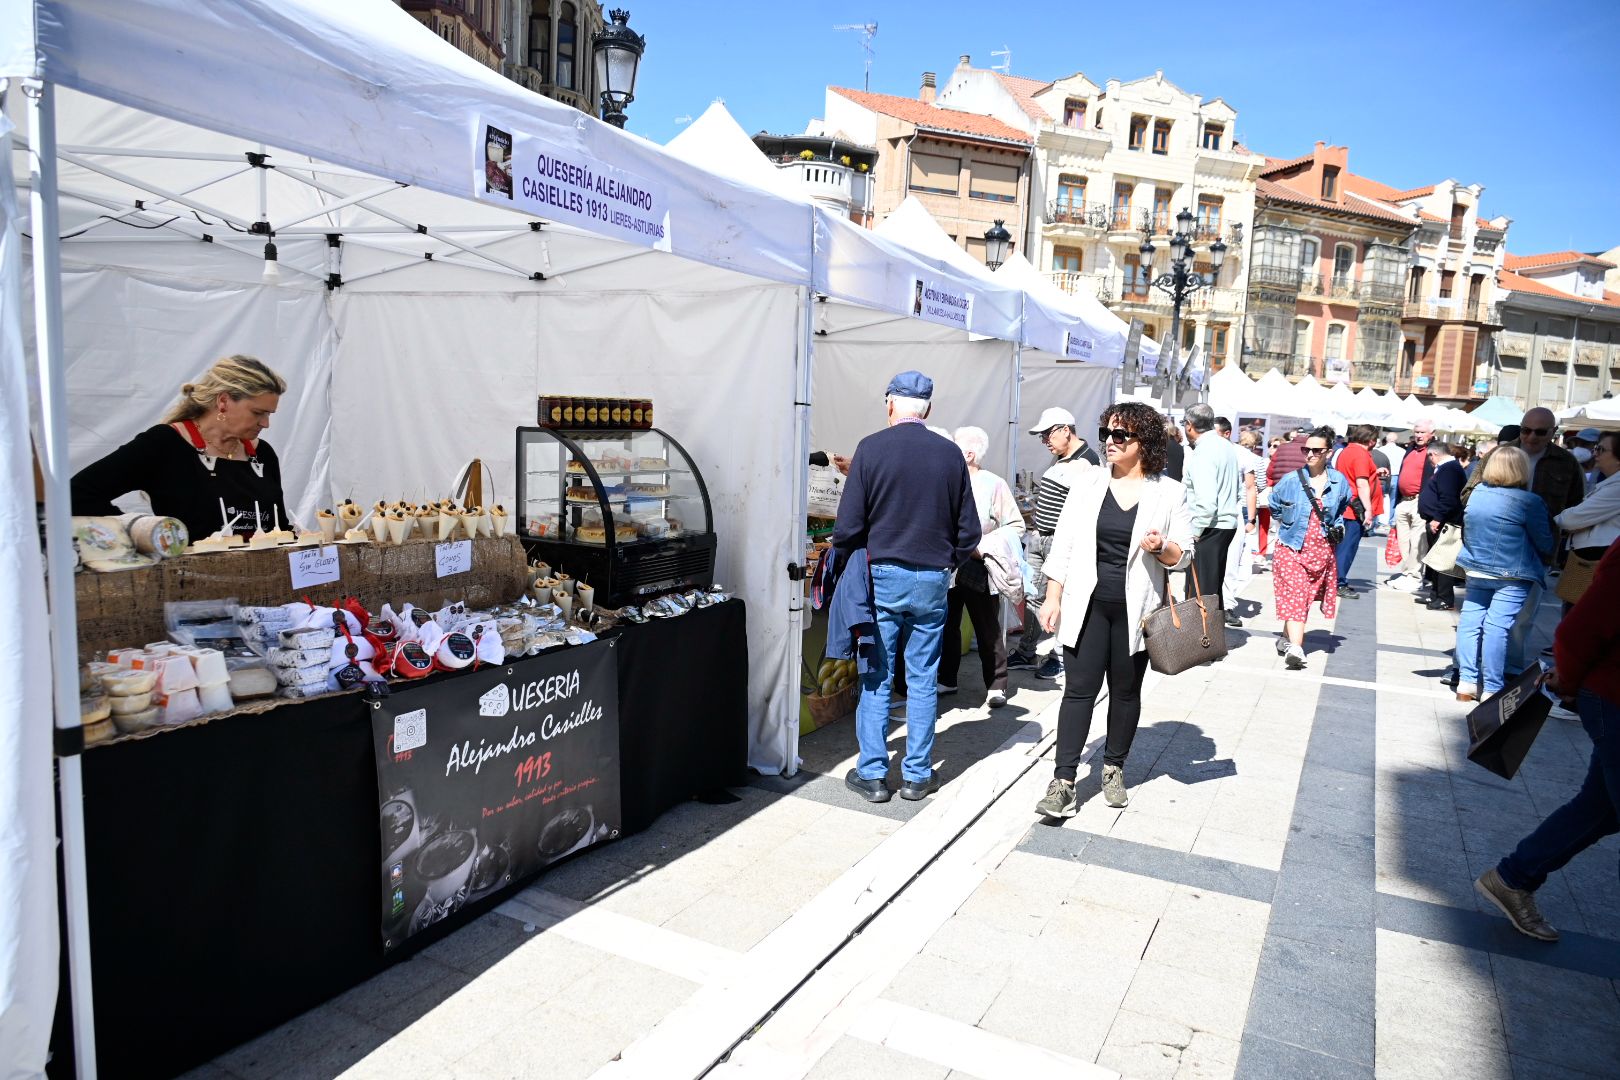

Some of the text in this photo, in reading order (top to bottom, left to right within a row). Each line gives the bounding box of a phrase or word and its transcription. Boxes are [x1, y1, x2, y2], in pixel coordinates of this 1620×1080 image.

[522, 176, 665, 238] CASIELLES 1913 LIERES-ASTURIAS
[537, 154, 652, 211] QUESERÍA ALEJANDRO
[445, 699, 603, 777] Alejandro Casielles
[514, 751, 552, 788] 1913
